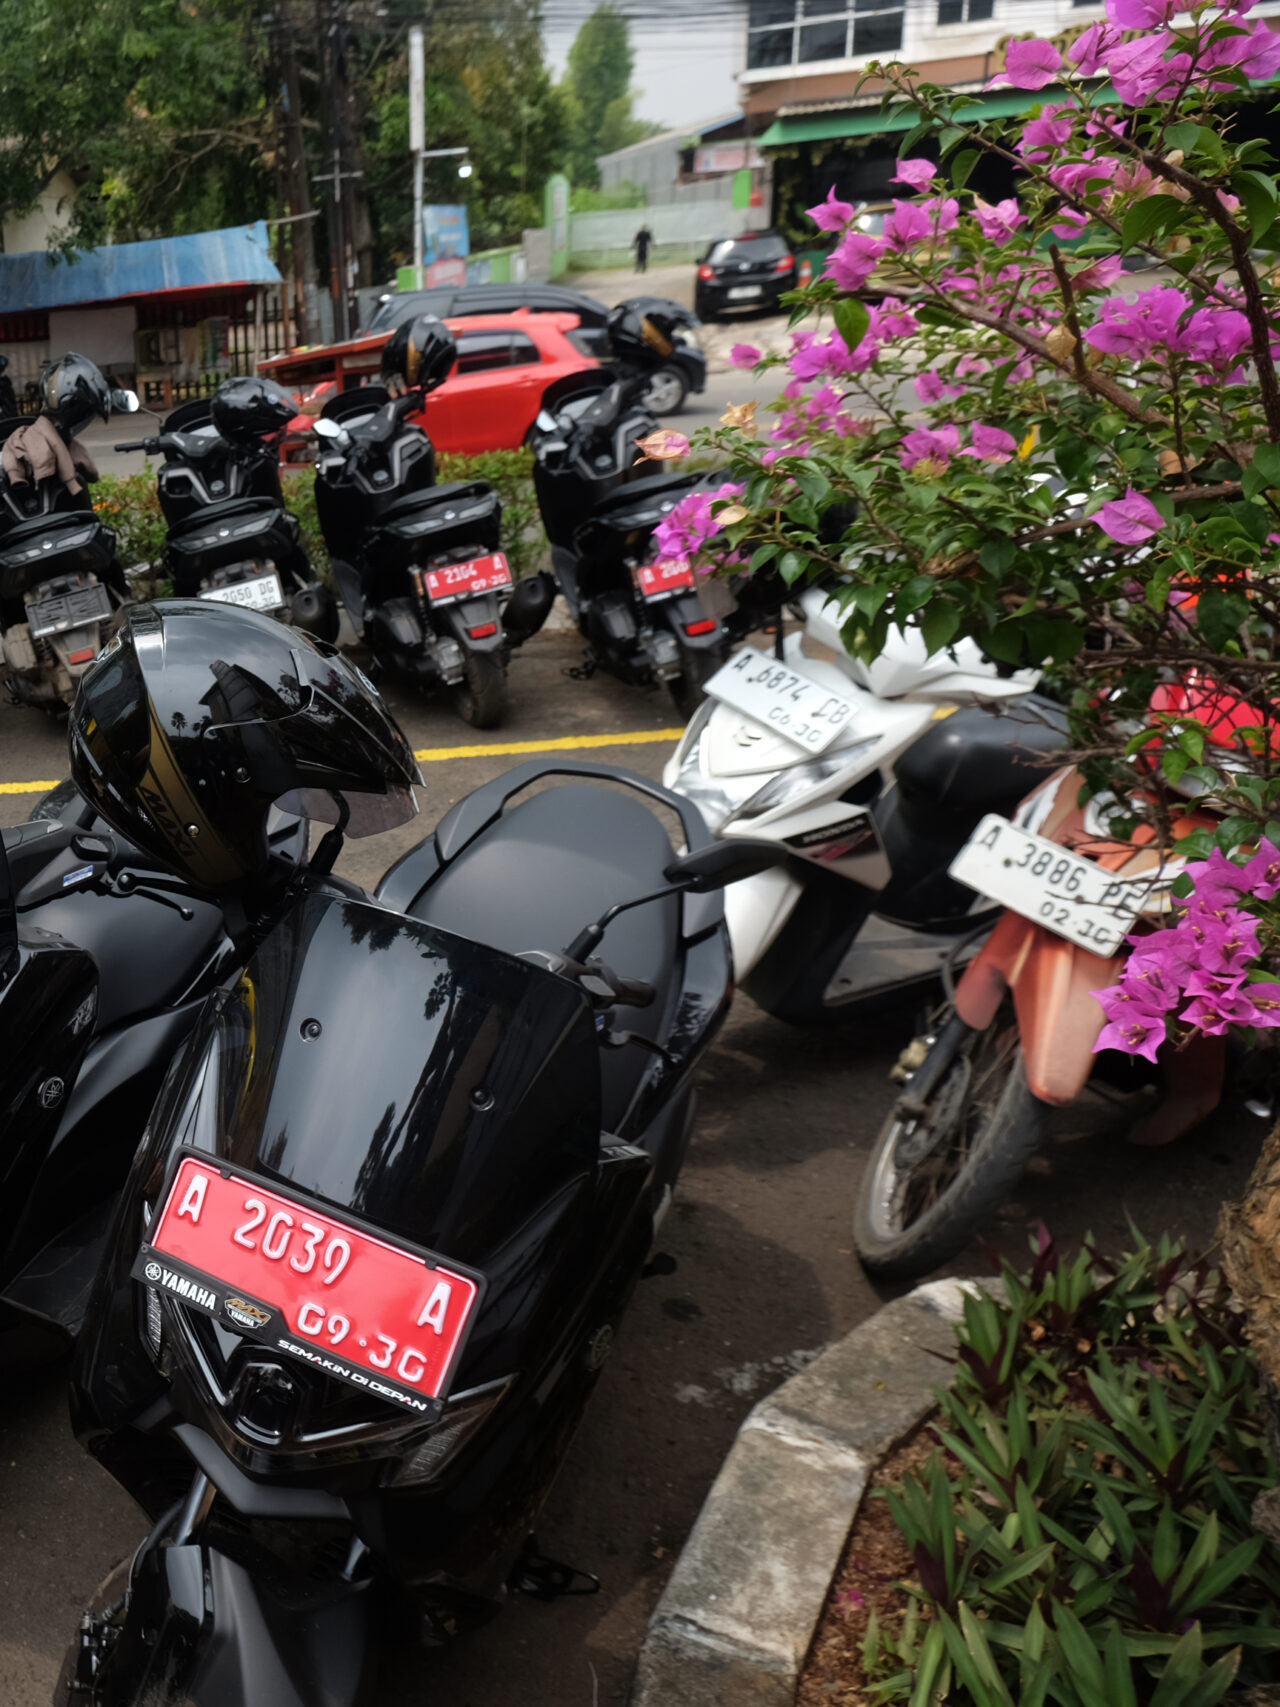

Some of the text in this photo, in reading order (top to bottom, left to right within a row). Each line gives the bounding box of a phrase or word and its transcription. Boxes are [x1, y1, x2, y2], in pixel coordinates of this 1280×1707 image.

[732, 654, 754, 671] A
[755, 666, 811, 702] 6874
[979, 825, 1002, 850] A
[1016, 843, 1087, 892] 3886
[177, 1174, 452, 1335] A 2039 A
[160, 1269, 217, 1310] YAMAHA
[278, 1339, 351, 1377] SEMAKIN
[369, 1381, 428, 1412] DEPAN
